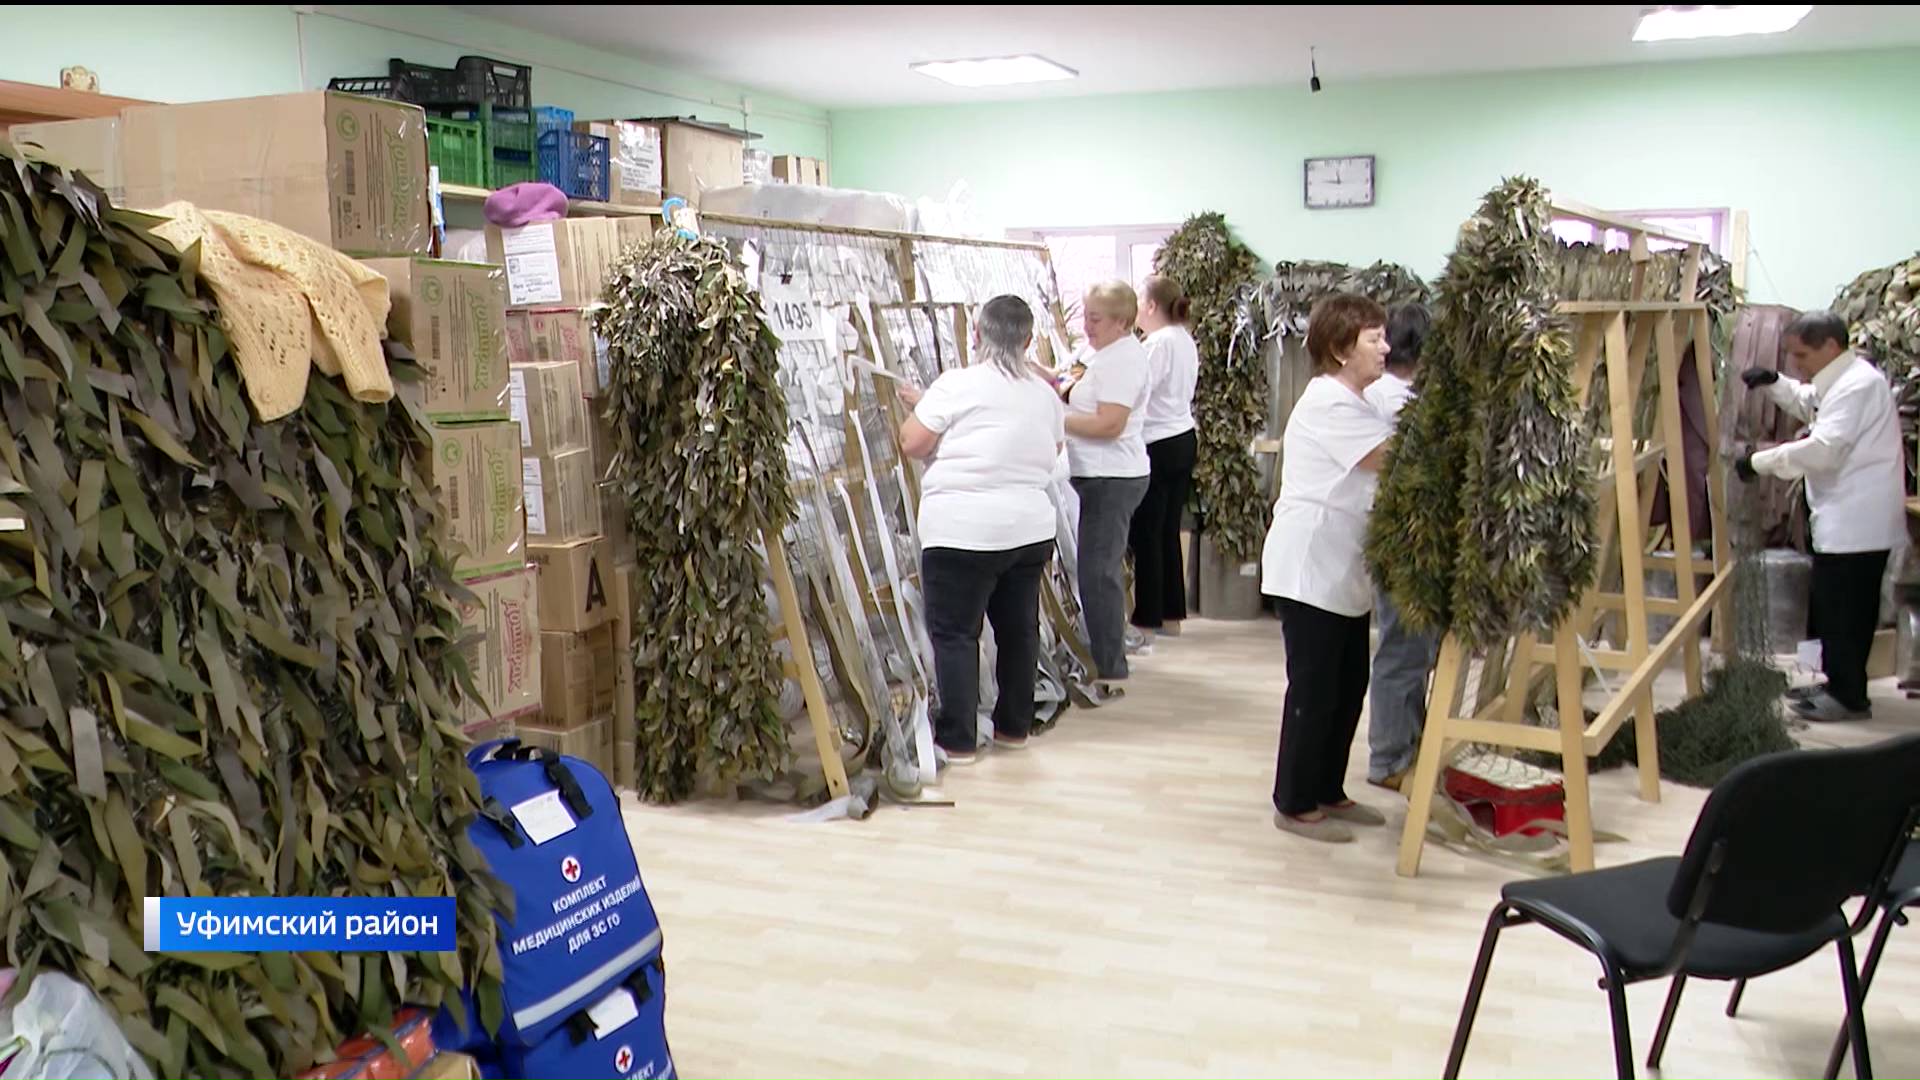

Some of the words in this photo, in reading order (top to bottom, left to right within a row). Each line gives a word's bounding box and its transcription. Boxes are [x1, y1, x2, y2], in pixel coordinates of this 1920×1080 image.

[774, 302, 812, 330] 1495
[551, 874, 607, 914] КОМПЛЕКТ
[511, 902, 603, 955] МЕДИЦИНСКИХ
[567, 930, 592, 954] ДЛЯ
[607, 912, 620, 930] ГО
